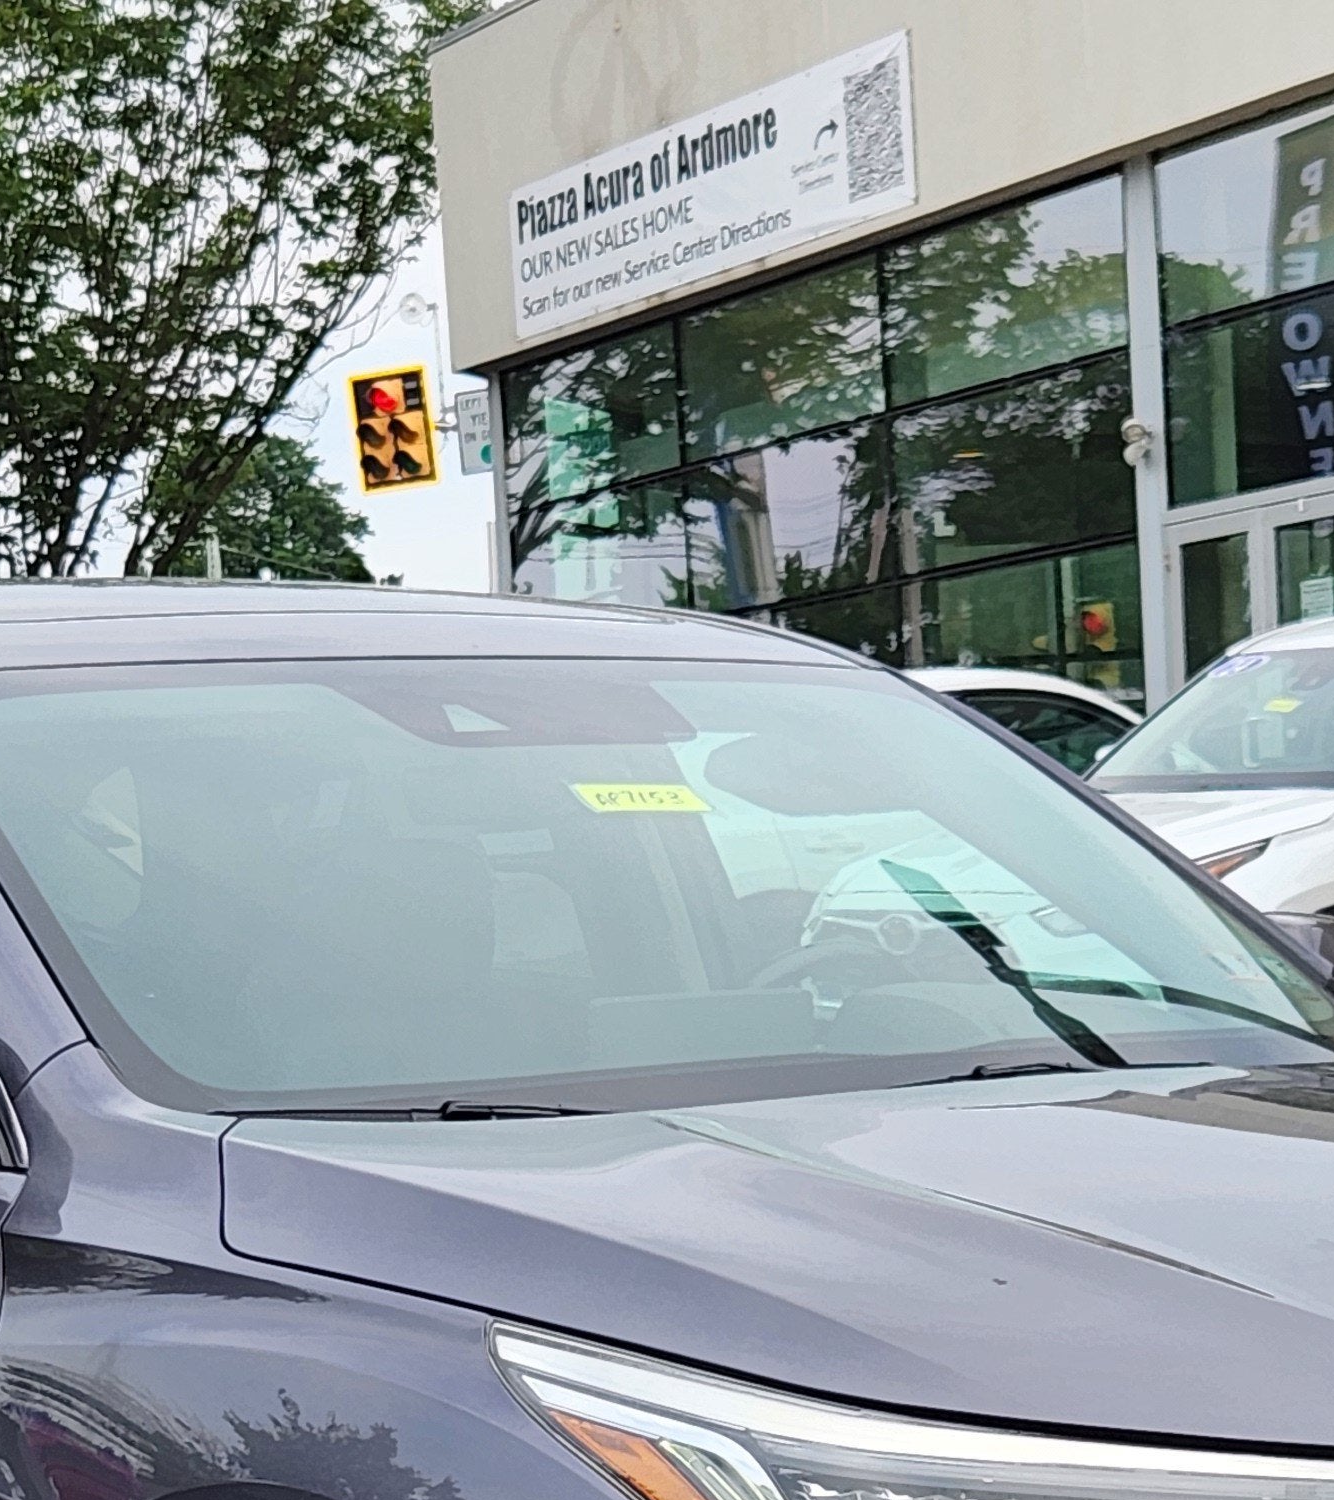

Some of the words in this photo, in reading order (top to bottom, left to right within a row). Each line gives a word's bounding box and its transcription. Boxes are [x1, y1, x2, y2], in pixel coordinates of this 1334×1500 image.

[517, 187, 579, 245] Piazza
[583, 160, 645, 220] Acura
[650, 139, 671, 193] of
[676, 107, 778, 184] Ardmore
[520, 249, 554, 283] OUR
[555, 233, 592, 271] NEW
[594, 216, 640, 257] SALES
[642, 195, 694, 240] HOME
[522, 292, 551, 320] Scan
[551, 285, 571, 309] for
[572, 279, 594, 303] our
[595, 270, 622, 297] new
[624, 252, 671, 285] Service
[672, 233, 719, 267] Center
[719, 209, 792, 251] Directions
